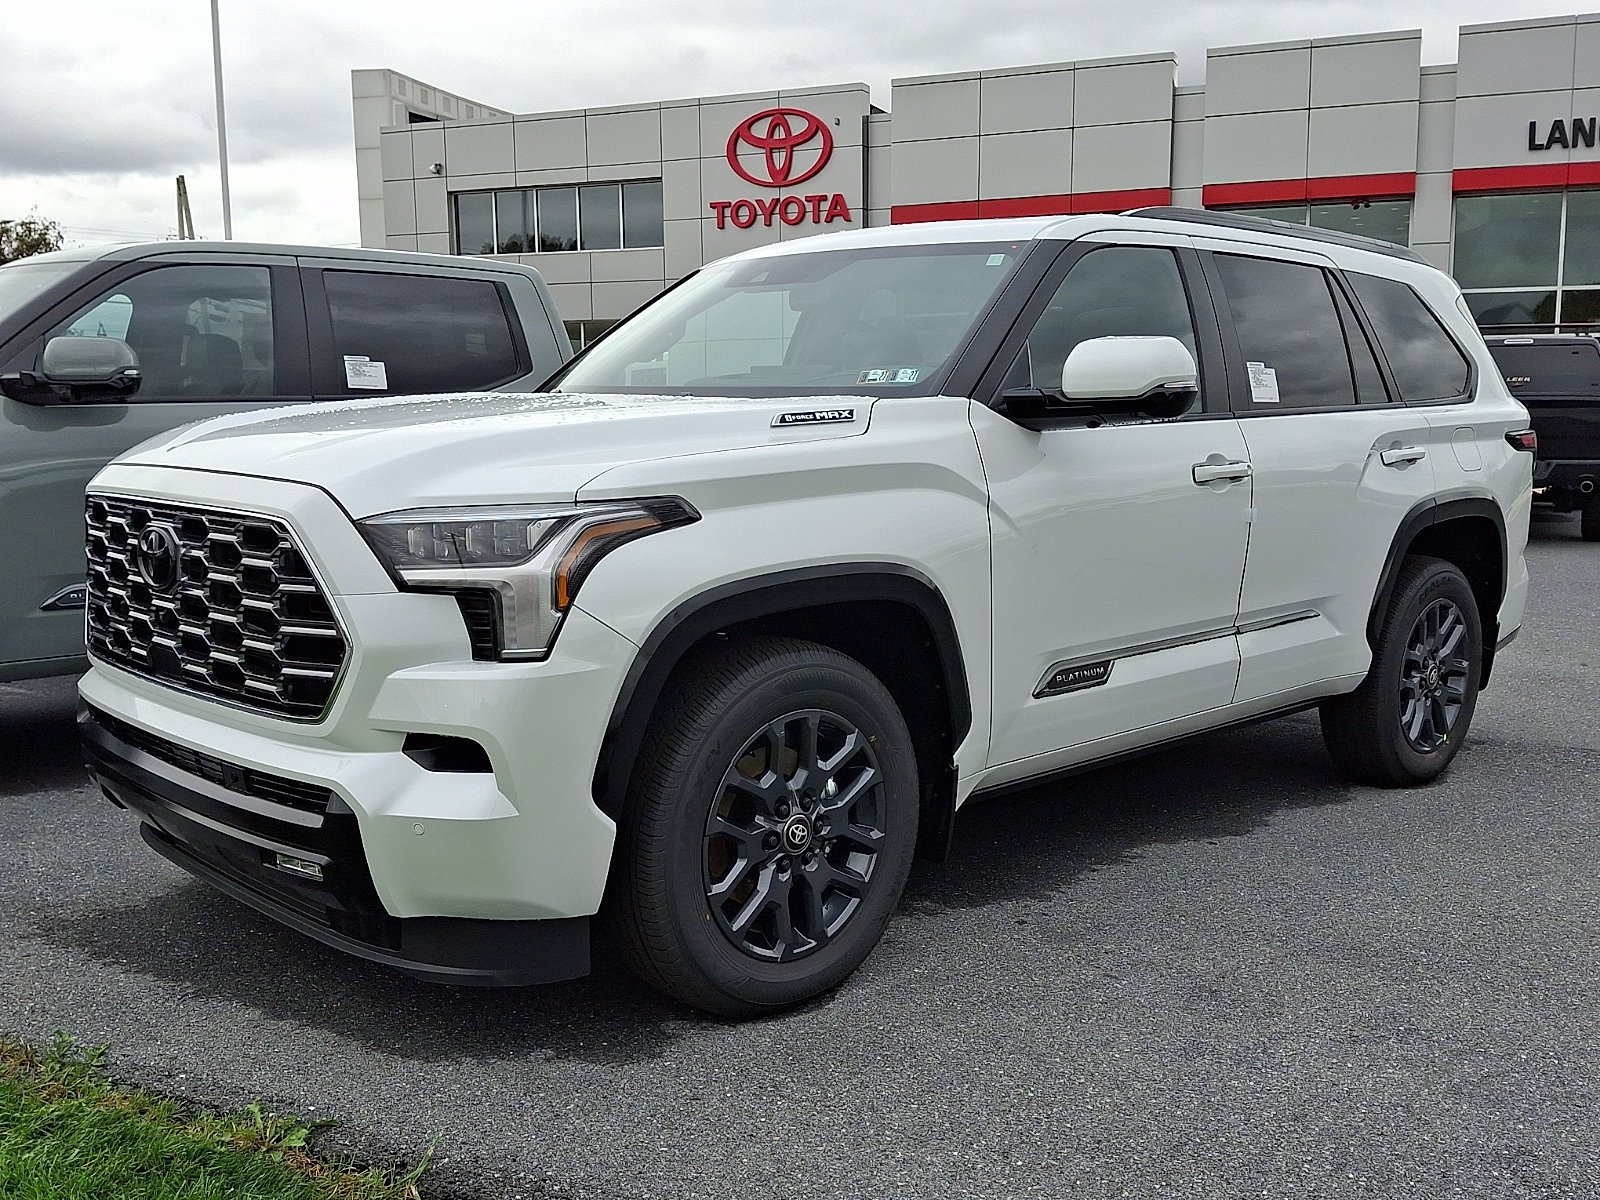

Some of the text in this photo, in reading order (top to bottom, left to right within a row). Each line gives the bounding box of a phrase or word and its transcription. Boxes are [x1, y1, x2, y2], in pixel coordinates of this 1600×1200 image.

[1528, 117, 1600, 151] LAN
[709, 193, 852, 230] TOYOTA
[815, 410, 852, 420] MAX
[1056, 667, 1105, 683] PLATINUM
